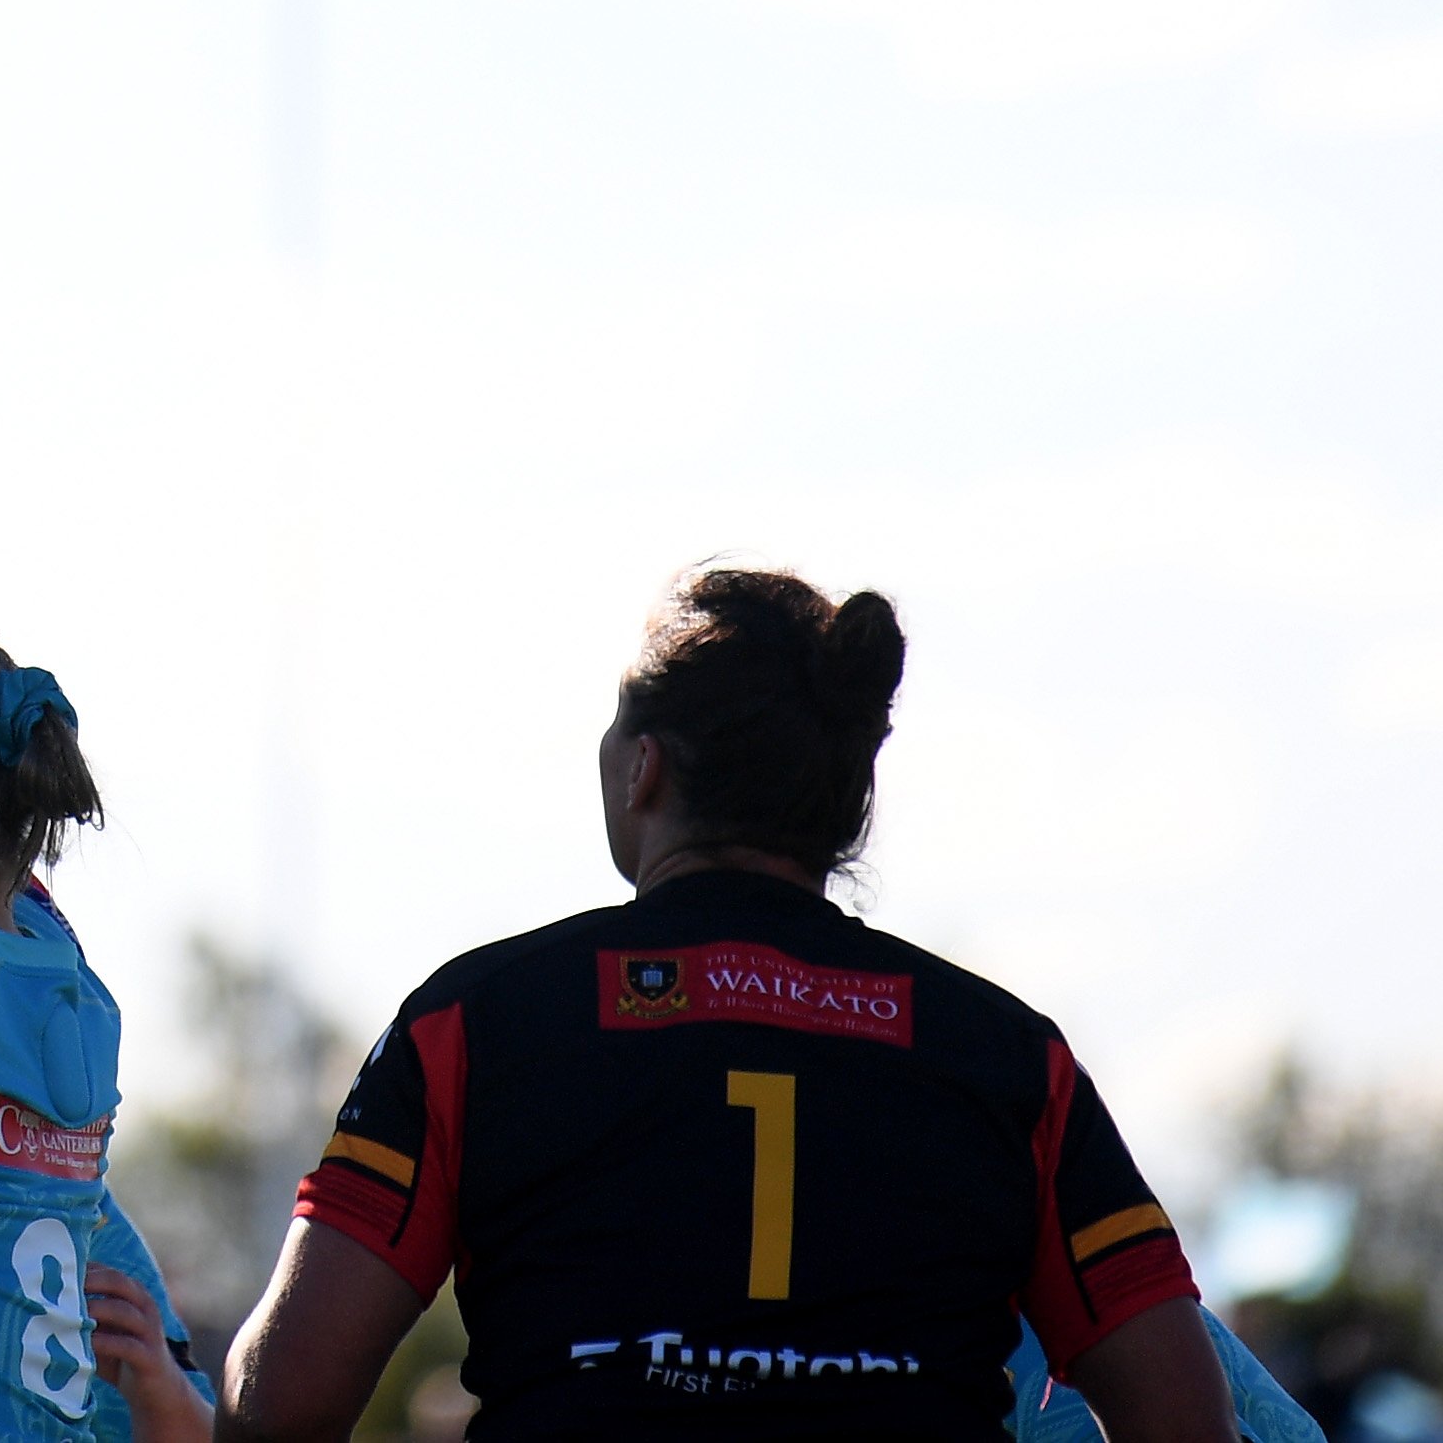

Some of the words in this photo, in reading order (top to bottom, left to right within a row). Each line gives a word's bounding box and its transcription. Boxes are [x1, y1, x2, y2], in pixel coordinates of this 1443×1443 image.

[704, 968, 899, 1022] WAIKATO
[727, 1069, 796, 1300] 1
[12, 1217, 92, 1420] 8
